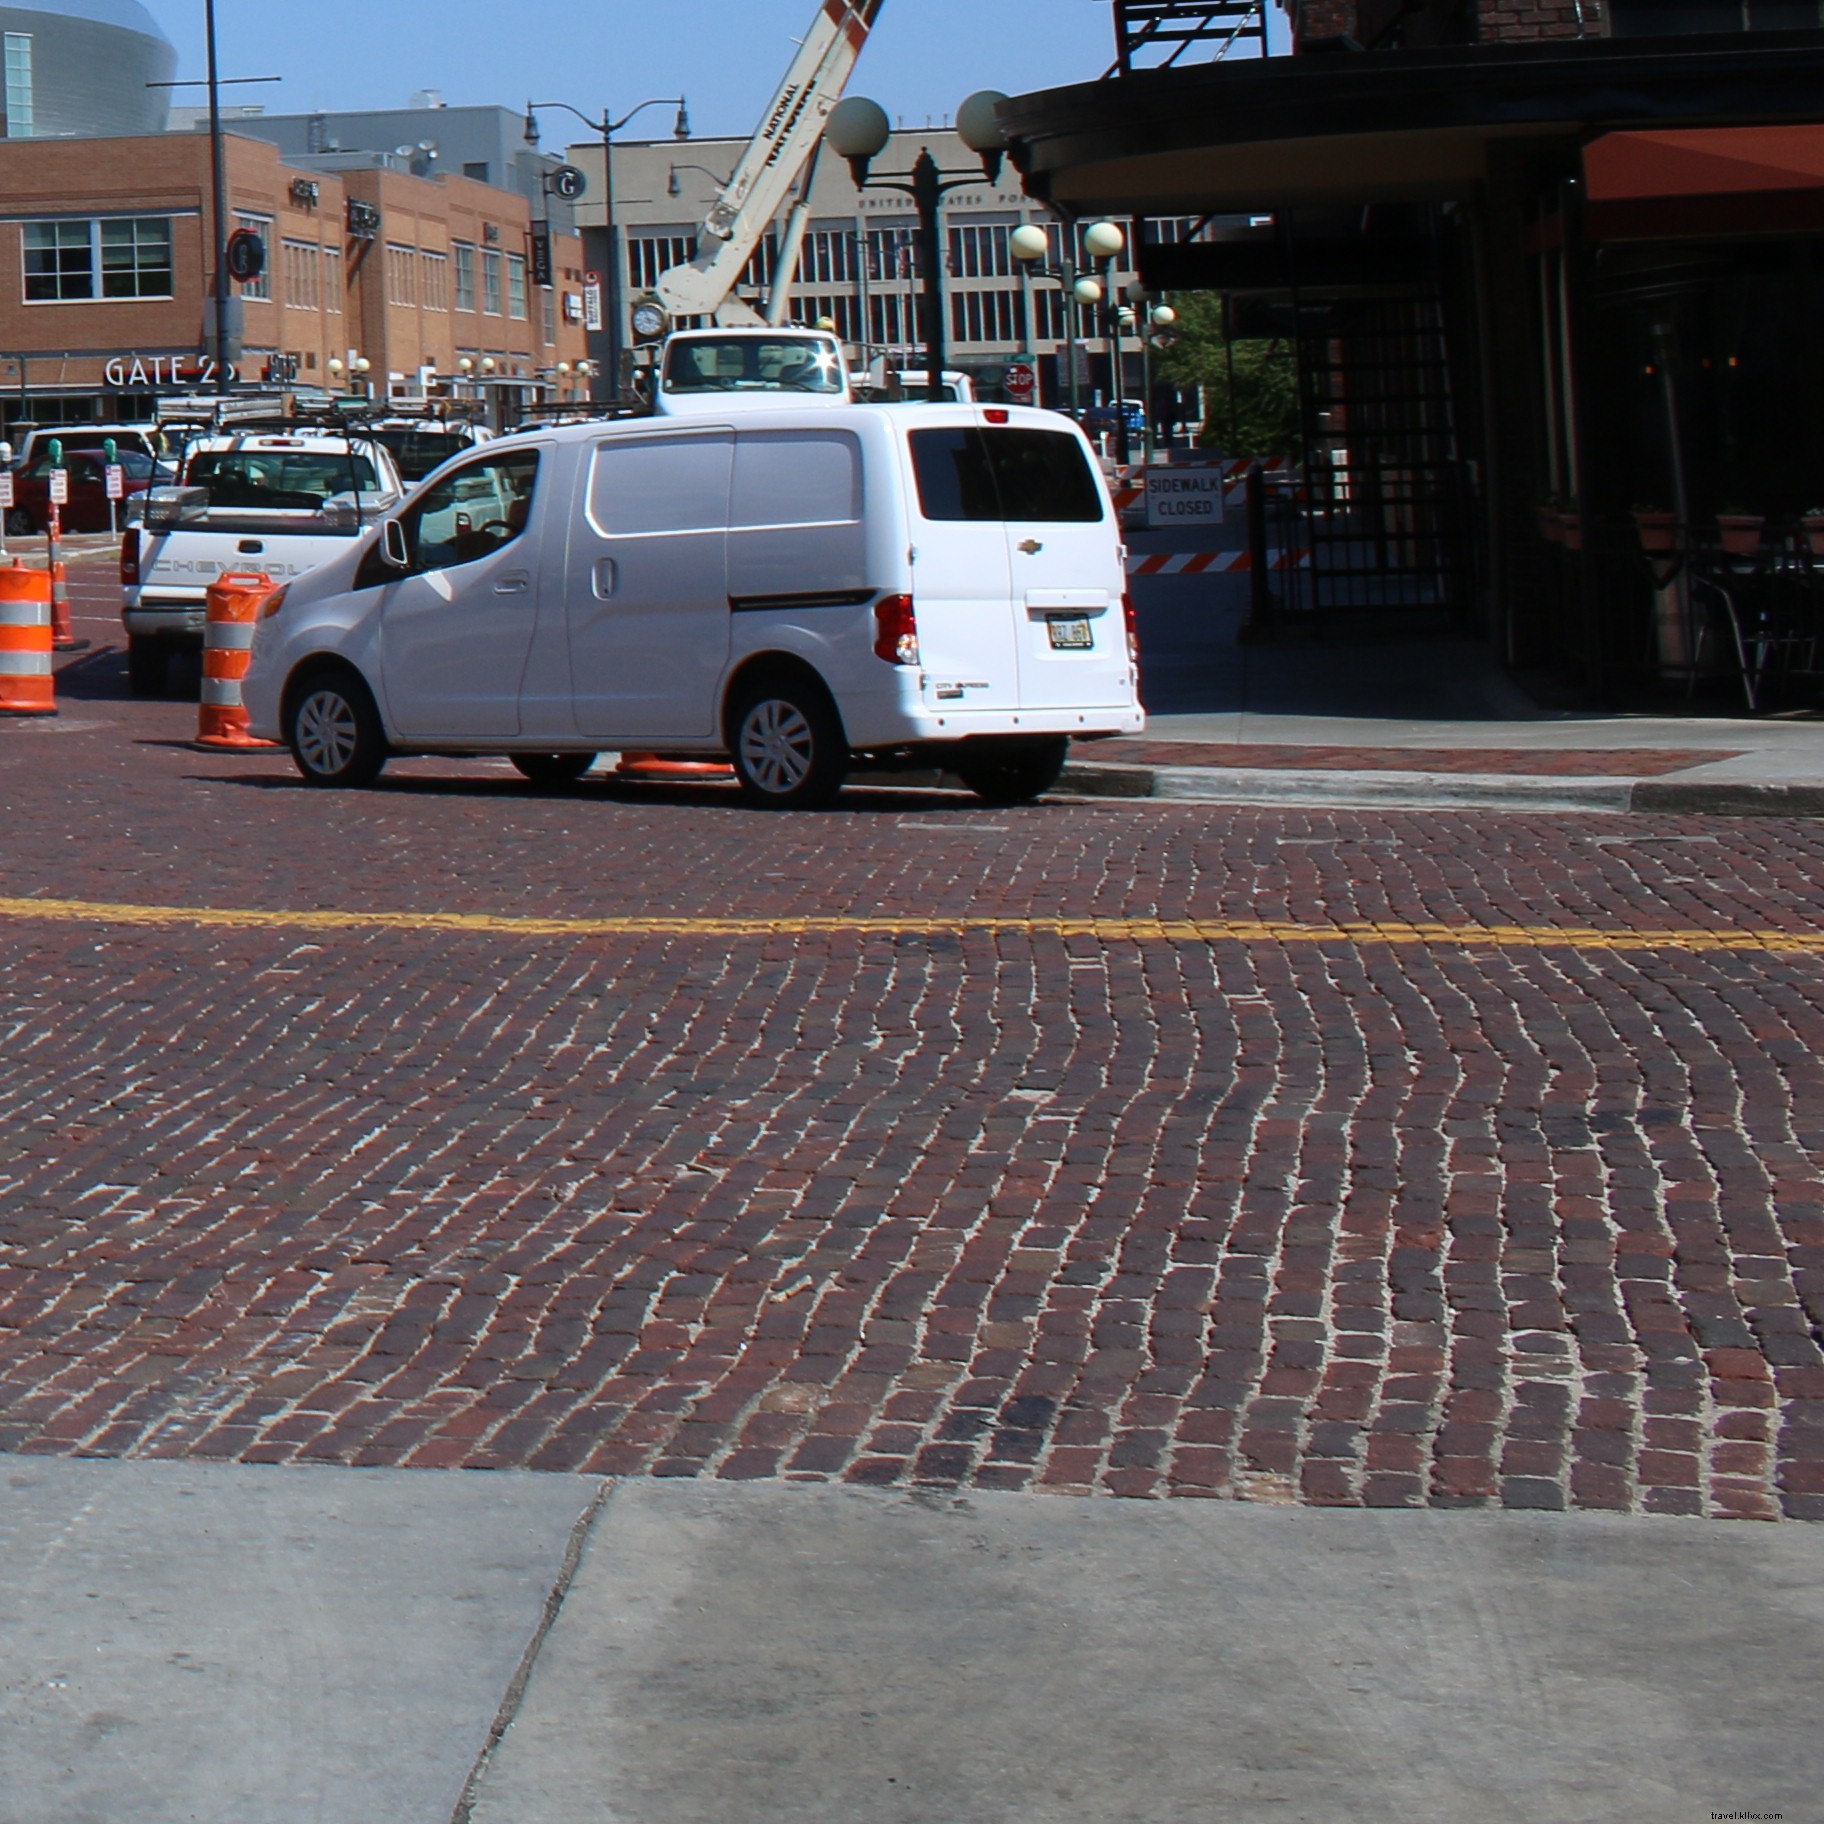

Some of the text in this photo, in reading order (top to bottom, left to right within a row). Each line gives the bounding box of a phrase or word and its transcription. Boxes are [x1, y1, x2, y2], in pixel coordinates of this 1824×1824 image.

[762, 83, 799, 140] NATIONAL
[105, 356, 187, 386] GATE
[1006, 374, 1032, 386] STOP
[1149, 477, 1220, 493] SIDEWALK
[1158, 500, 1212, 516] CLOSED
[153, 559, 317, 575] CHEVROL
